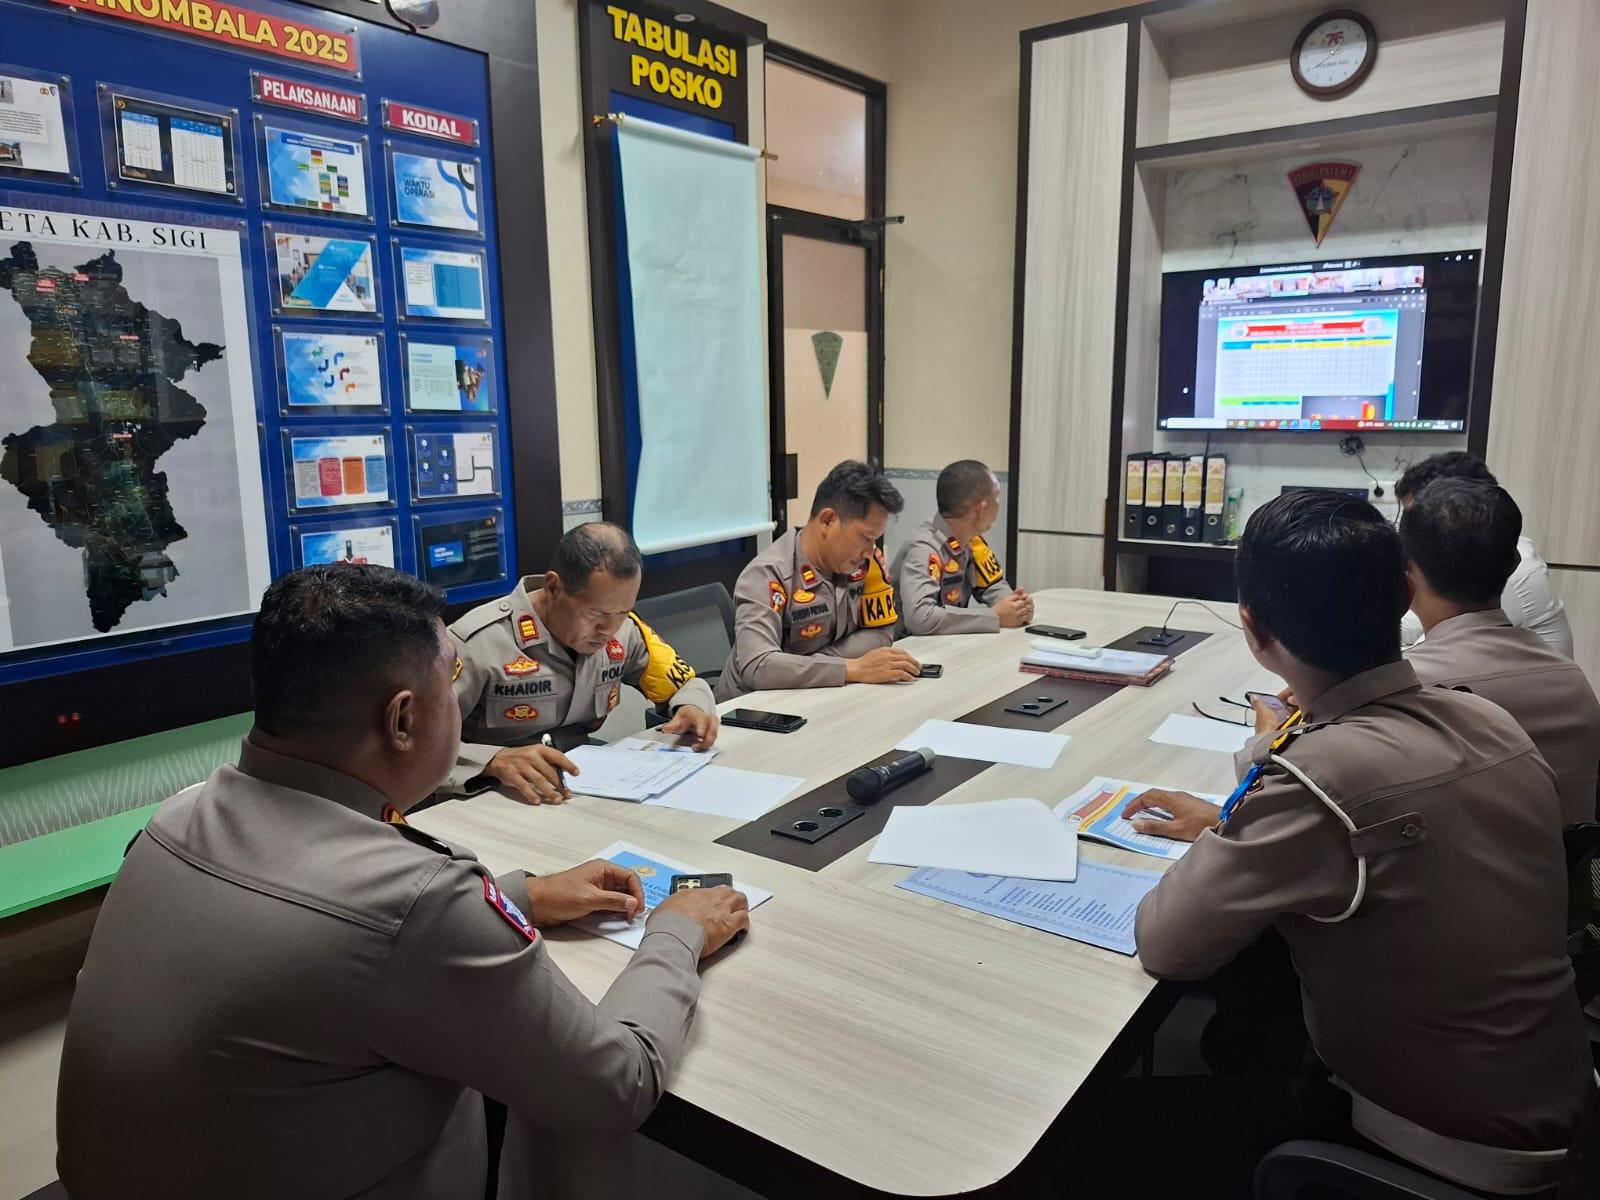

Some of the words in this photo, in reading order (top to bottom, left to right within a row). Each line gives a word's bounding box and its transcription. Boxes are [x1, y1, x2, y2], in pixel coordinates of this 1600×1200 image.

[284, 26, 349, 63] 2025
[607, 5, 737, 78] TABULASI
[262, 79, 357, 115] PELAKSANAAN
[631, 54, 723, 109] POSKO
[402, 108, 461, 137] KODAL
[403, 178, 431, 190] WAKTU
[72, 218, 141, 243] KAB.
[152, 226, 207, 250] SIGI
[494, 679, 552, 696] KHAIDIR
